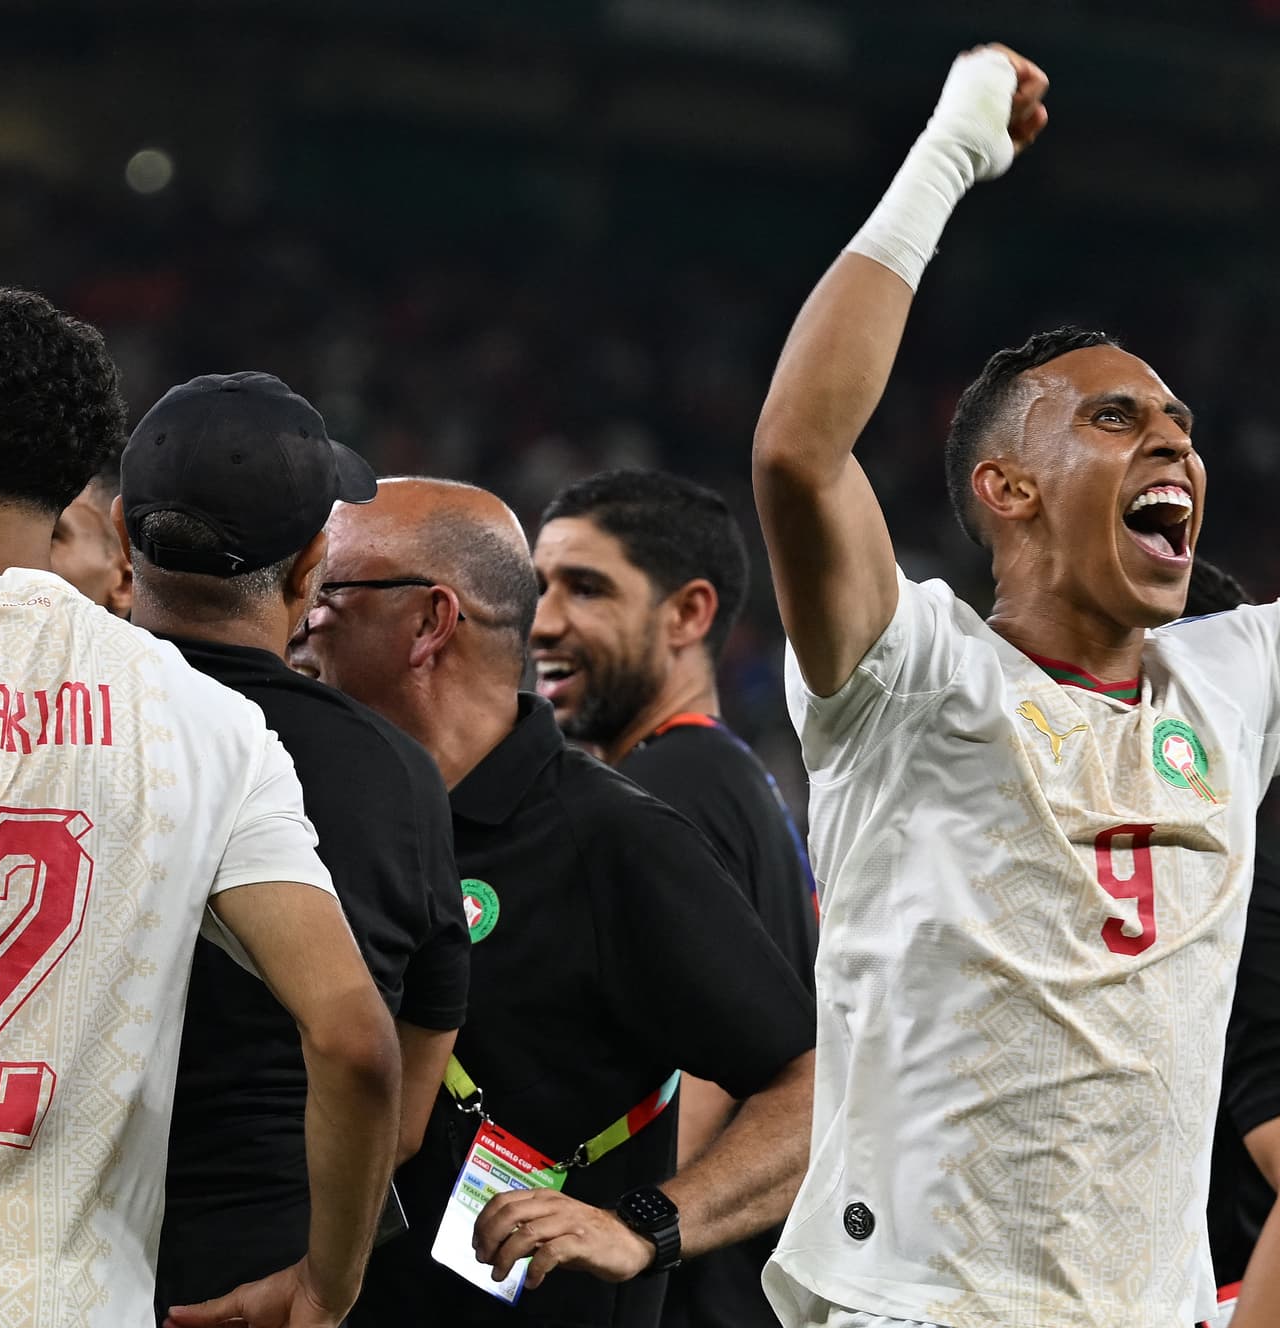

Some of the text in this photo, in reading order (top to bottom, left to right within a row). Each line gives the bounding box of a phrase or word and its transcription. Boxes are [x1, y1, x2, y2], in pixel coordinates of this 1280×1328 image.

[1094, 823, 1158, 957] 9
[481, 1135, 496, 1149] FIFA
[495, 1143, 519, 1162] WORLD
[518, 1158, 533, 1170] CUP
